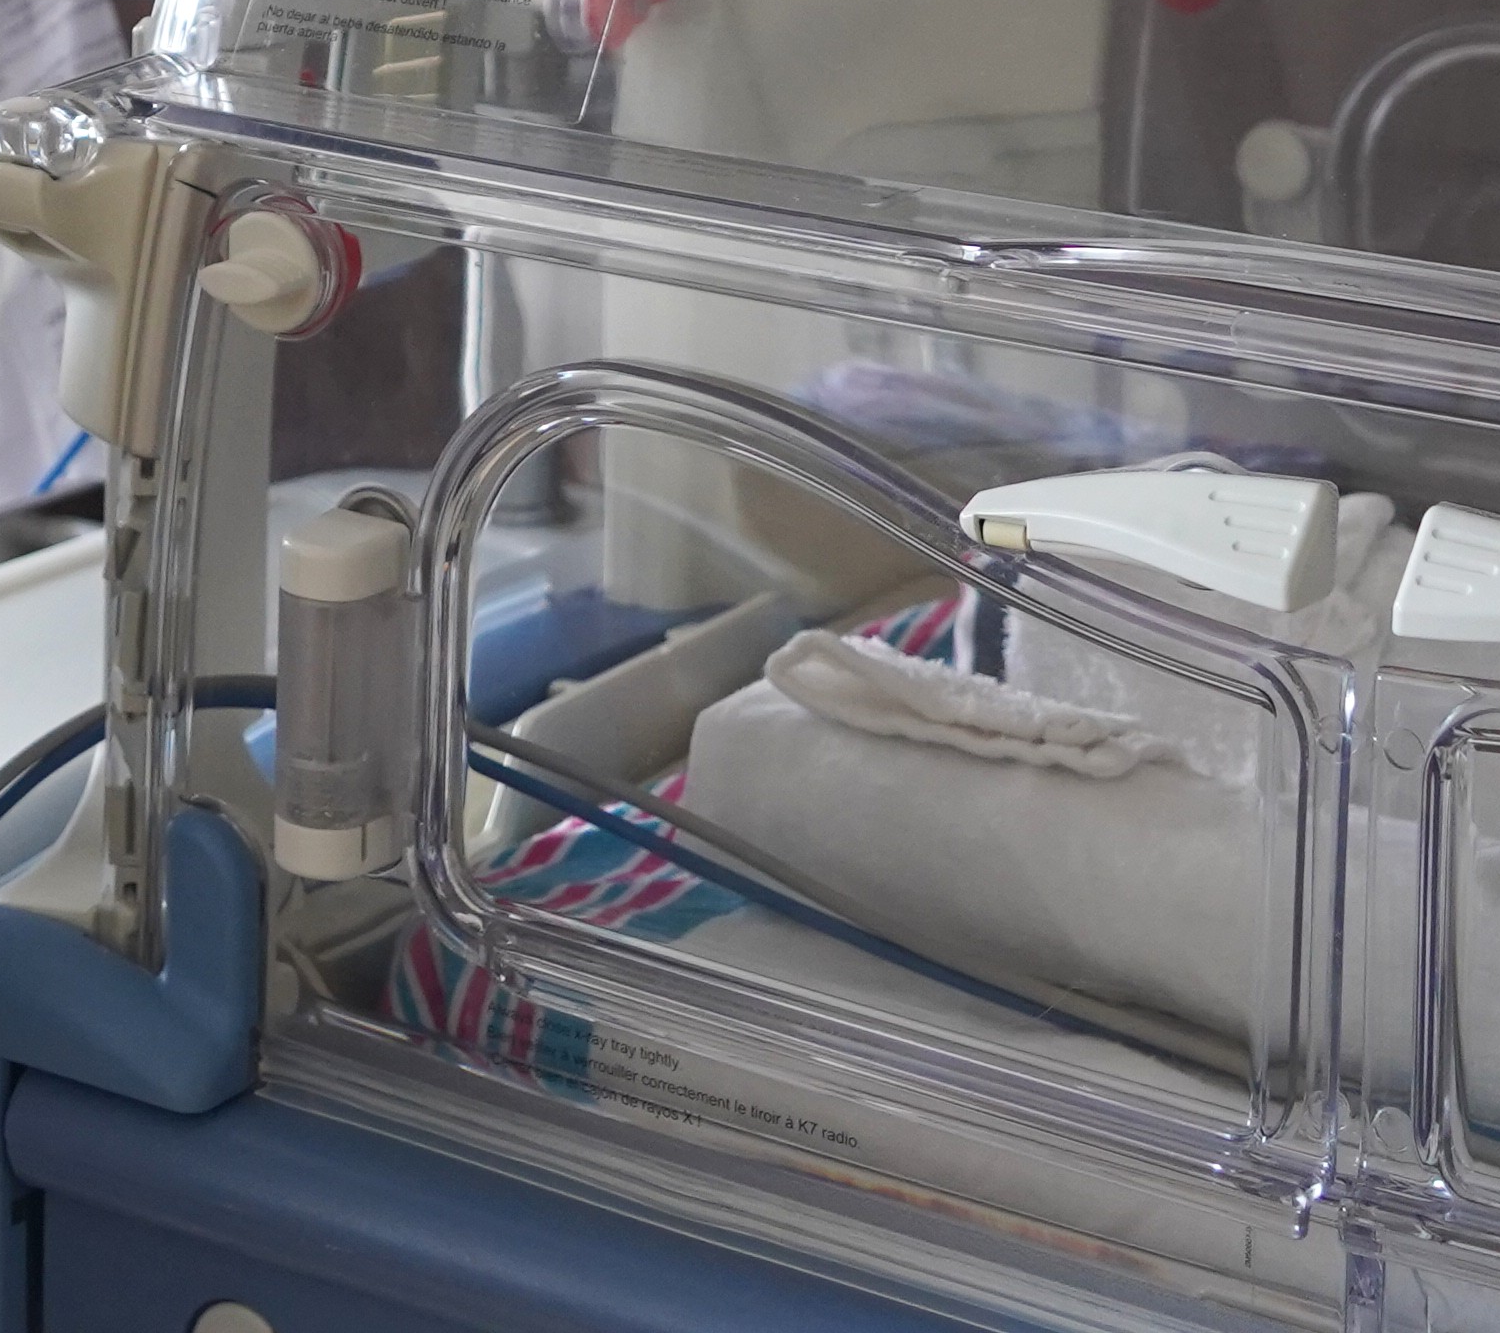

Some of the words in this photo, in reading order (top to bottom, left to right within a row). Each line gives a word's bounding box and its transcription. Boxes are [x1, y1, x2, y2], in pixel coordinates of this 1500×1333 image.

[256, 21, 295, 36] puerta
[298, 26, 338, 42] abierta
[286, 8, 317, 24] dejar
[320, 13, 331, 25] al
[365, 19, 439, 42] desatendido
[442, 32, 492, 50] estando
[494, 39, 506, 52] la
[573, 1030, 609, 1052] x-ray
[611, 1038, 637, 1058] tray
[620, 1093, 638, 1109] de
[641, 1099, 679, 1120] rayos
[682, 1109, 694, 1126] X
[641, 1072, 730, 1110] correctement
[734, 1099, 747, 1115] le
[751, 1105, 781, 1126] tiroir
[784, 1114, 794, 1130] à
[798, 1118, 818, 1135] K7
